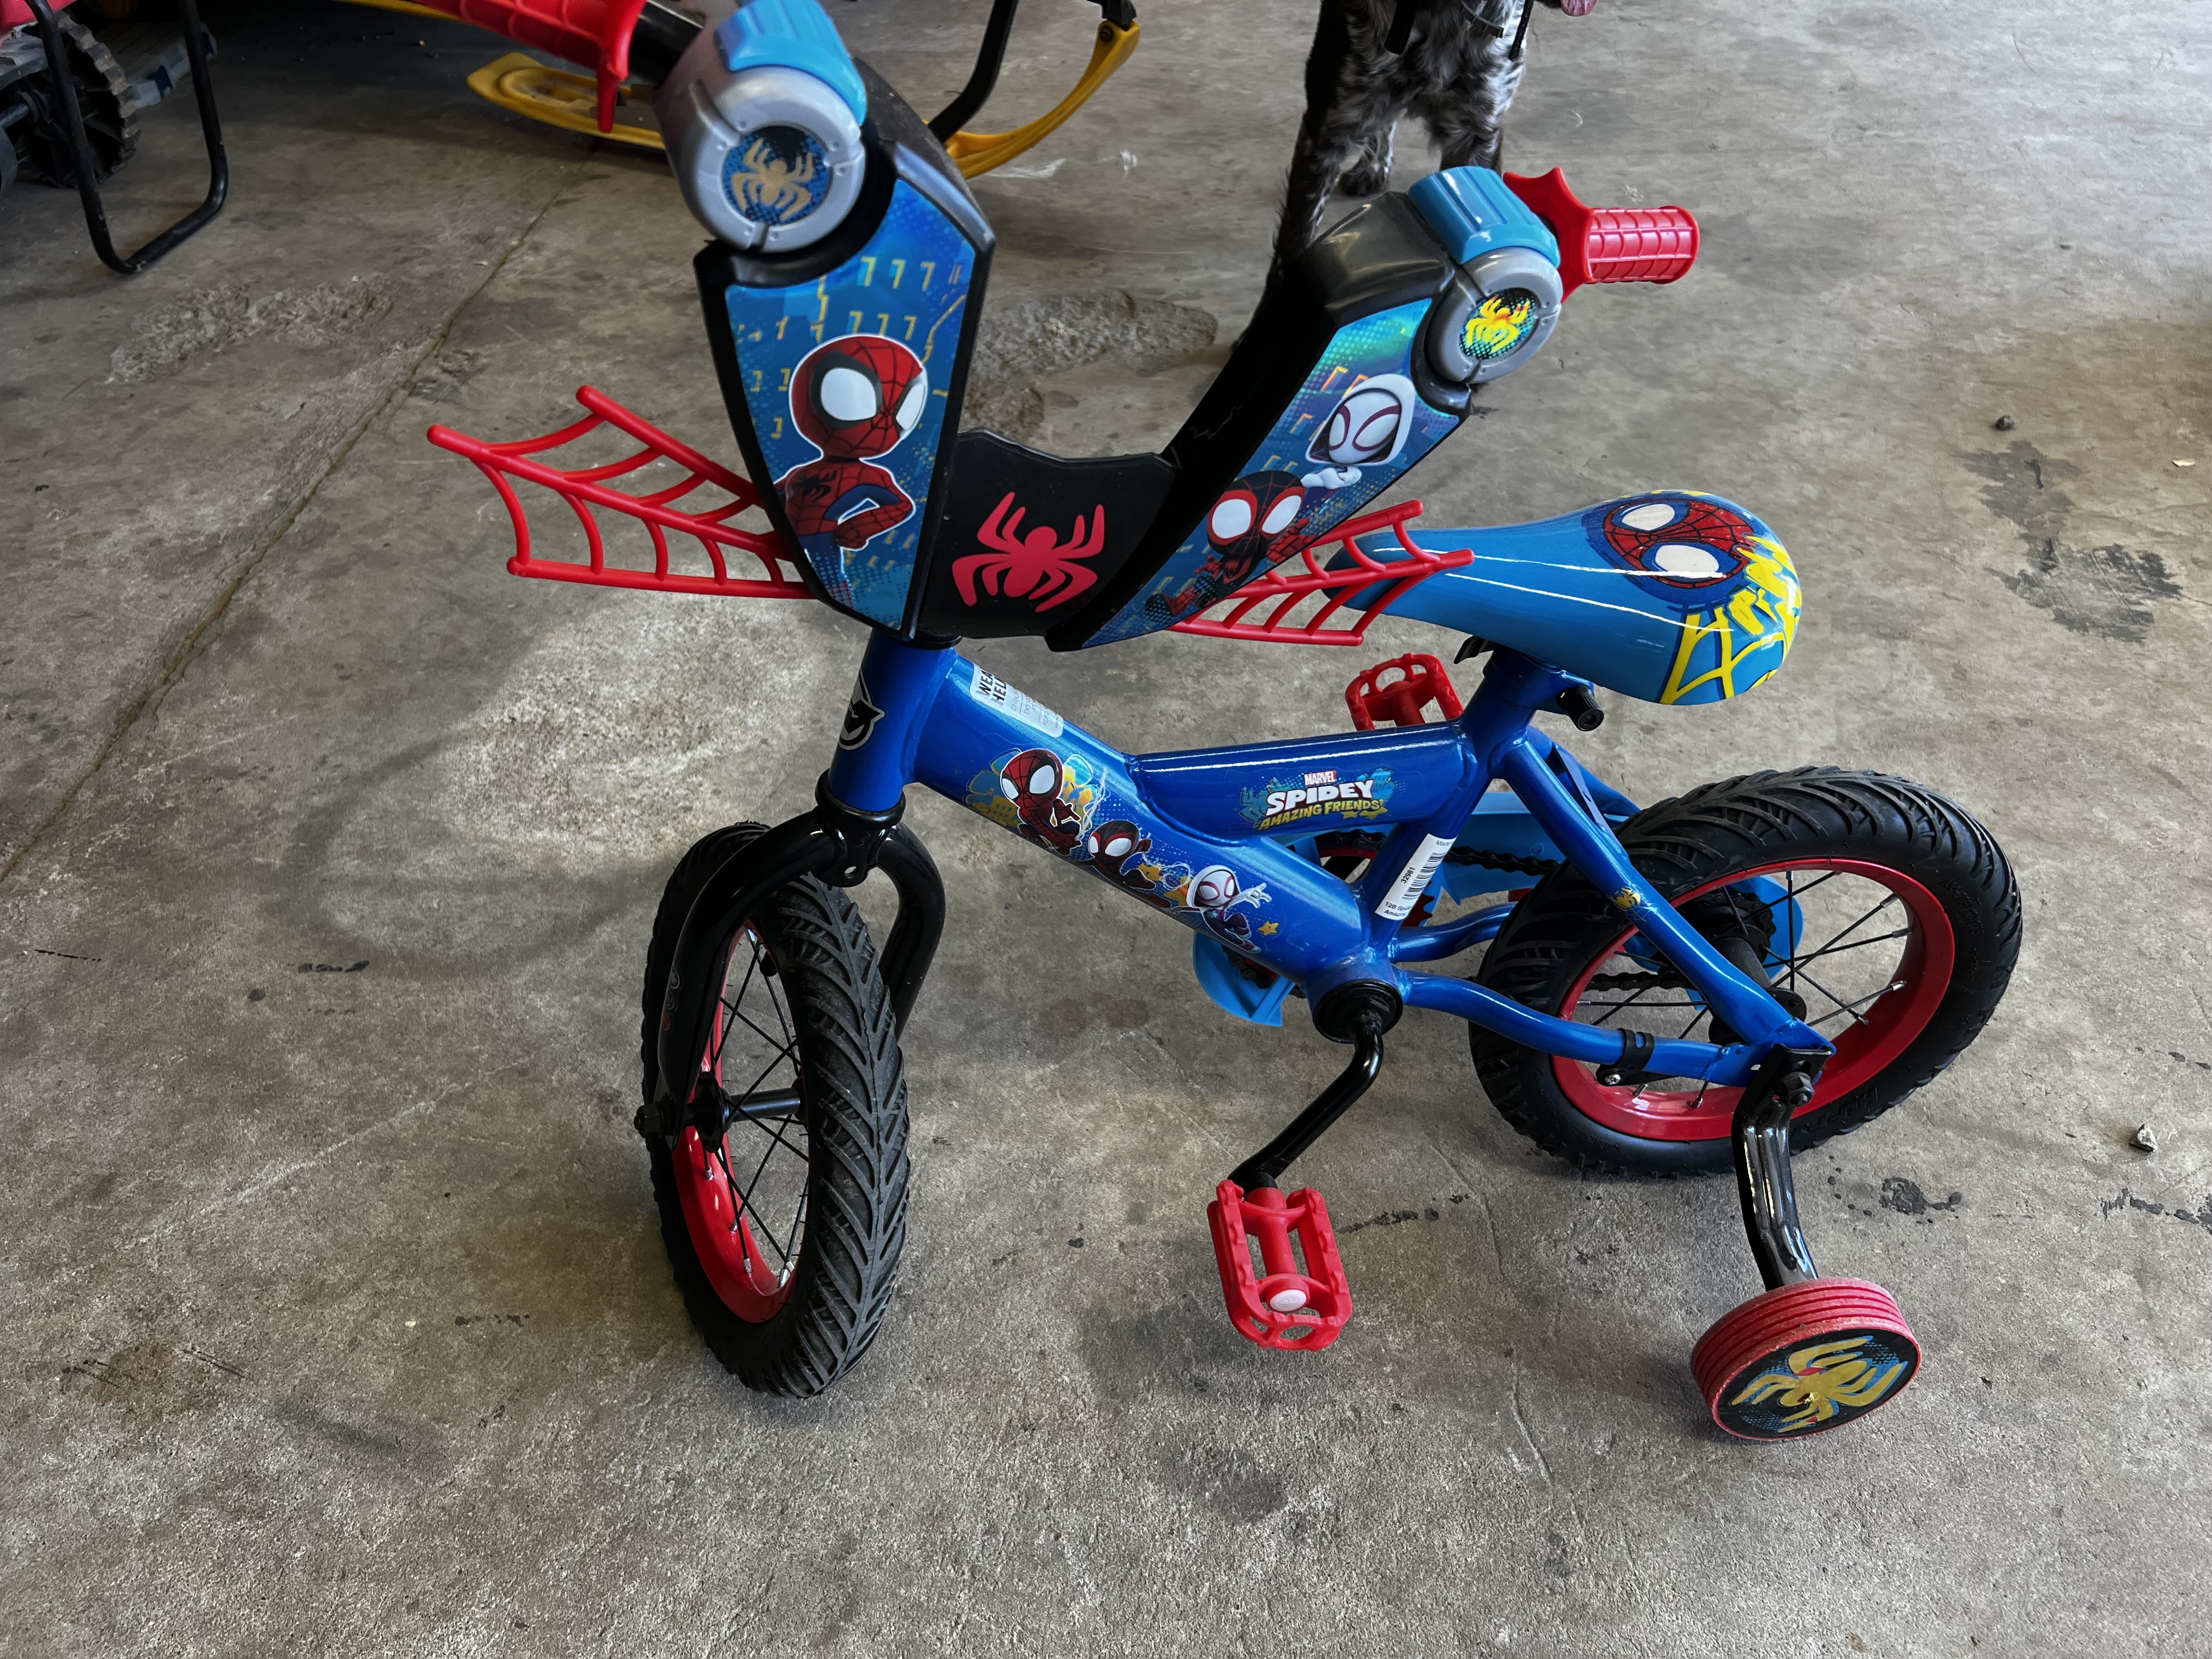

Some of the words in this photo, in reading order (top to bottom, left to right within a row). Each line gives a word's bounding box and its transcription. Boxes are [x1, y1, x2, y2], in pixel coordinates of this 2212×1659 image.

[1304, 770, 1336, 786] MARVEL
[1266, 779, 1374, 816] SPIDEY
[1257, 804, 1322, 831] AMAZING
[1324, 799, 1380, 815] FRIENDS
[1401, 867, 1415, 883] 32981
